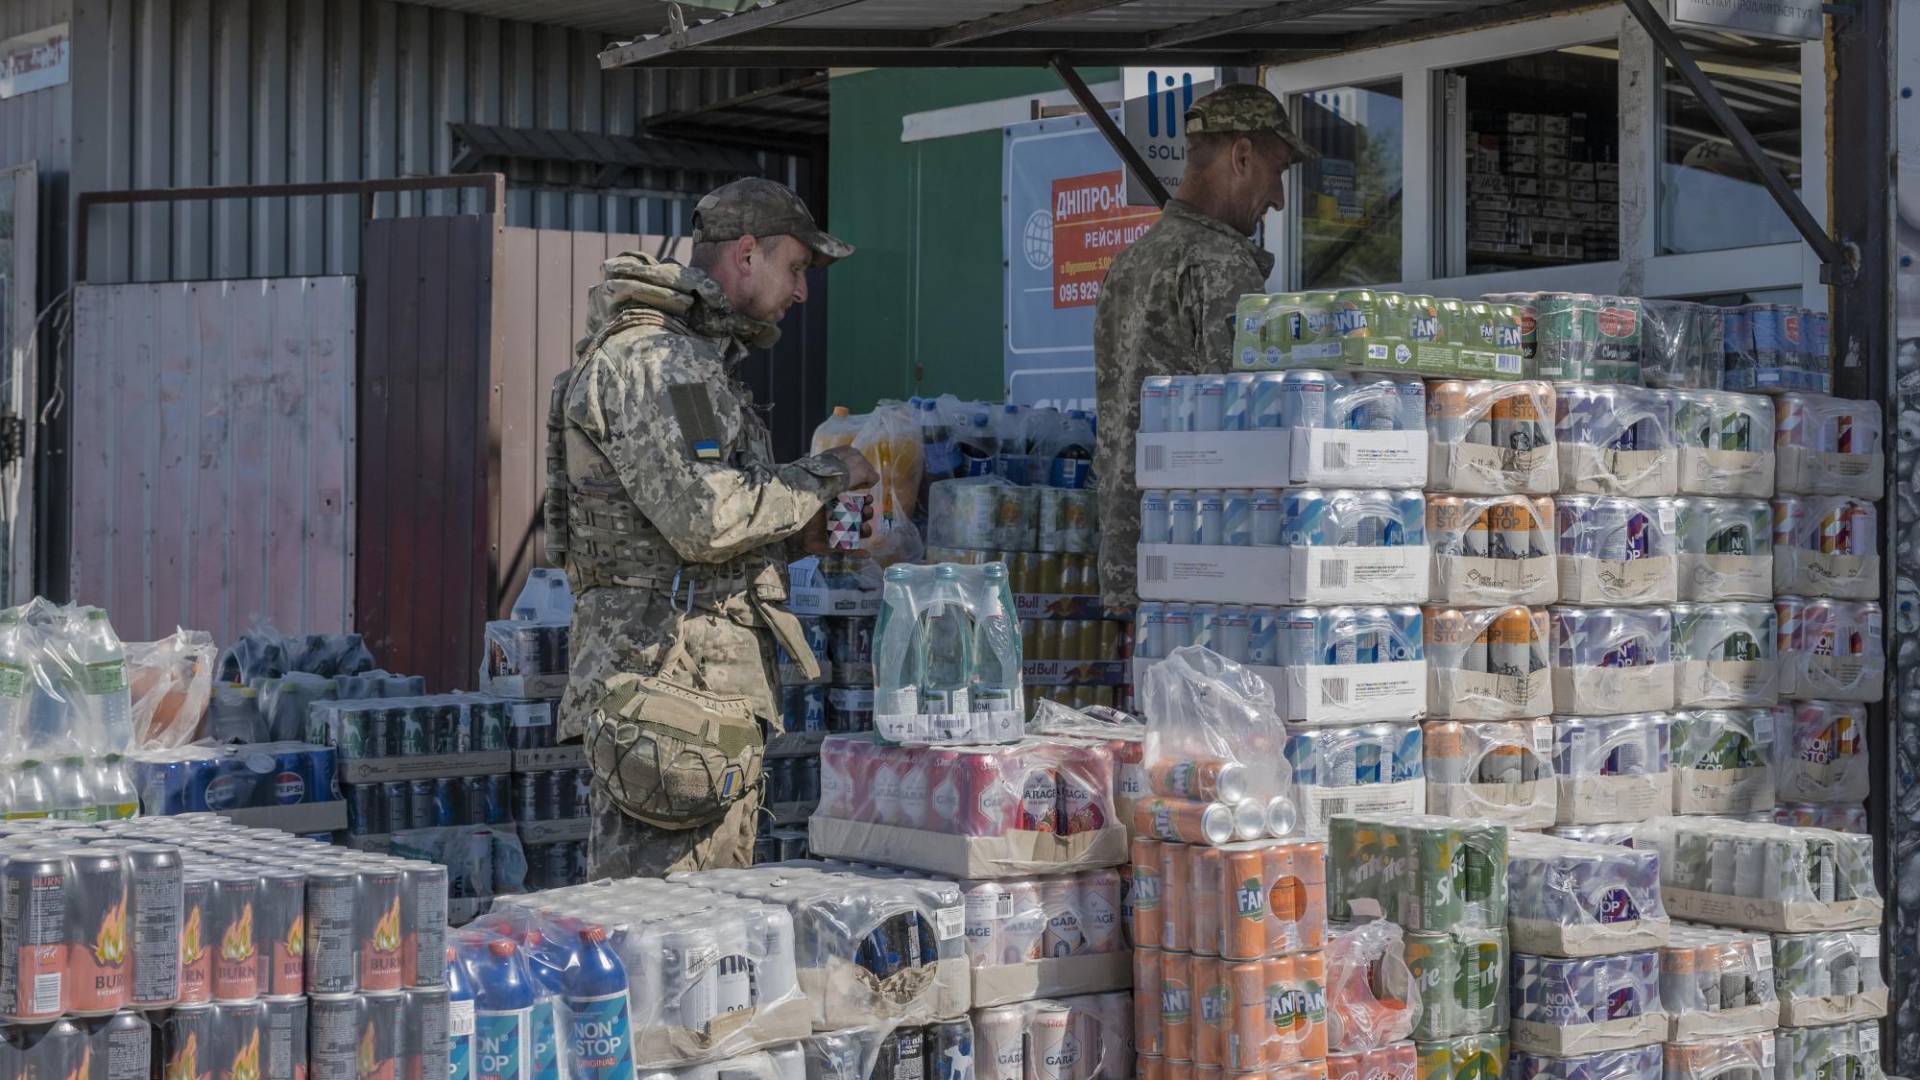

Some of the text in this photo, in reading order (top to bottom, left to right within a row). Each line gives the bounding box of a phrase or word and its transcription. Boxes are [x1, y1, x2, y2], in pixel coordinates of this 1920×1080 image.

[1085, 227, 1121, 249] РЕЙСИ
[1060, 280, 1099, 302] 095 929
[1037, 662, 1058, 675] Bull
[574, 1020, 612, 1039] NON
[576, 1037, 621, 1056] STOP
